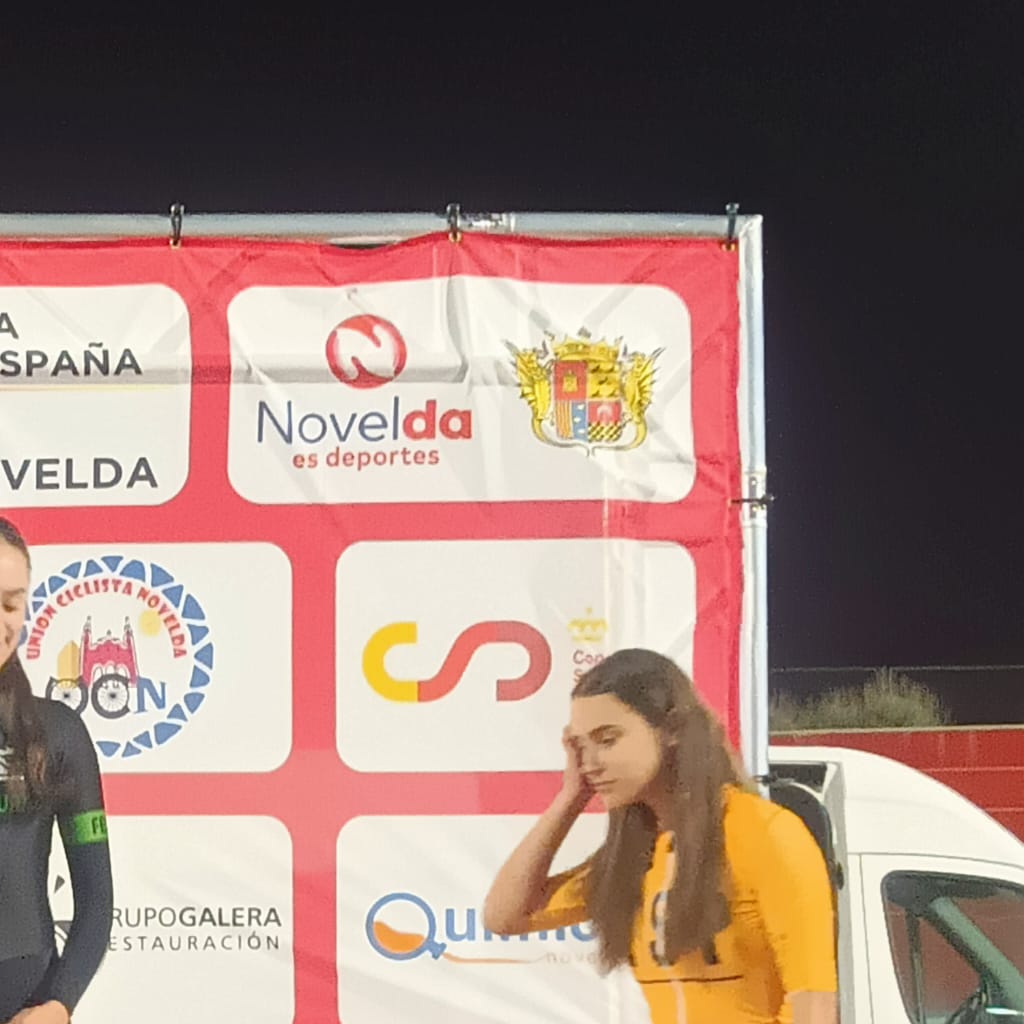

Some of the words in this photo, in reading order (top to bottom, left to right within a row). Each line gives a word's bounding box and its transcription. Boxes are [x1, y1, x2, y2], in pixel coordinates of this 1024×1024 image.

[256, 396, 473, 445] Novelda
[292, 450, 319, 469] es
[325, 445, 441, 472] deportes
[26, 603, 57, 660] UNION
[56, 578, 133, 608] CICLISTA
[135, 586, 188, 659] NOVELDA
[112, 906, 282, 928] RUPOGALERA
[108, 931, 280, 951] ESTAURACIÓN
